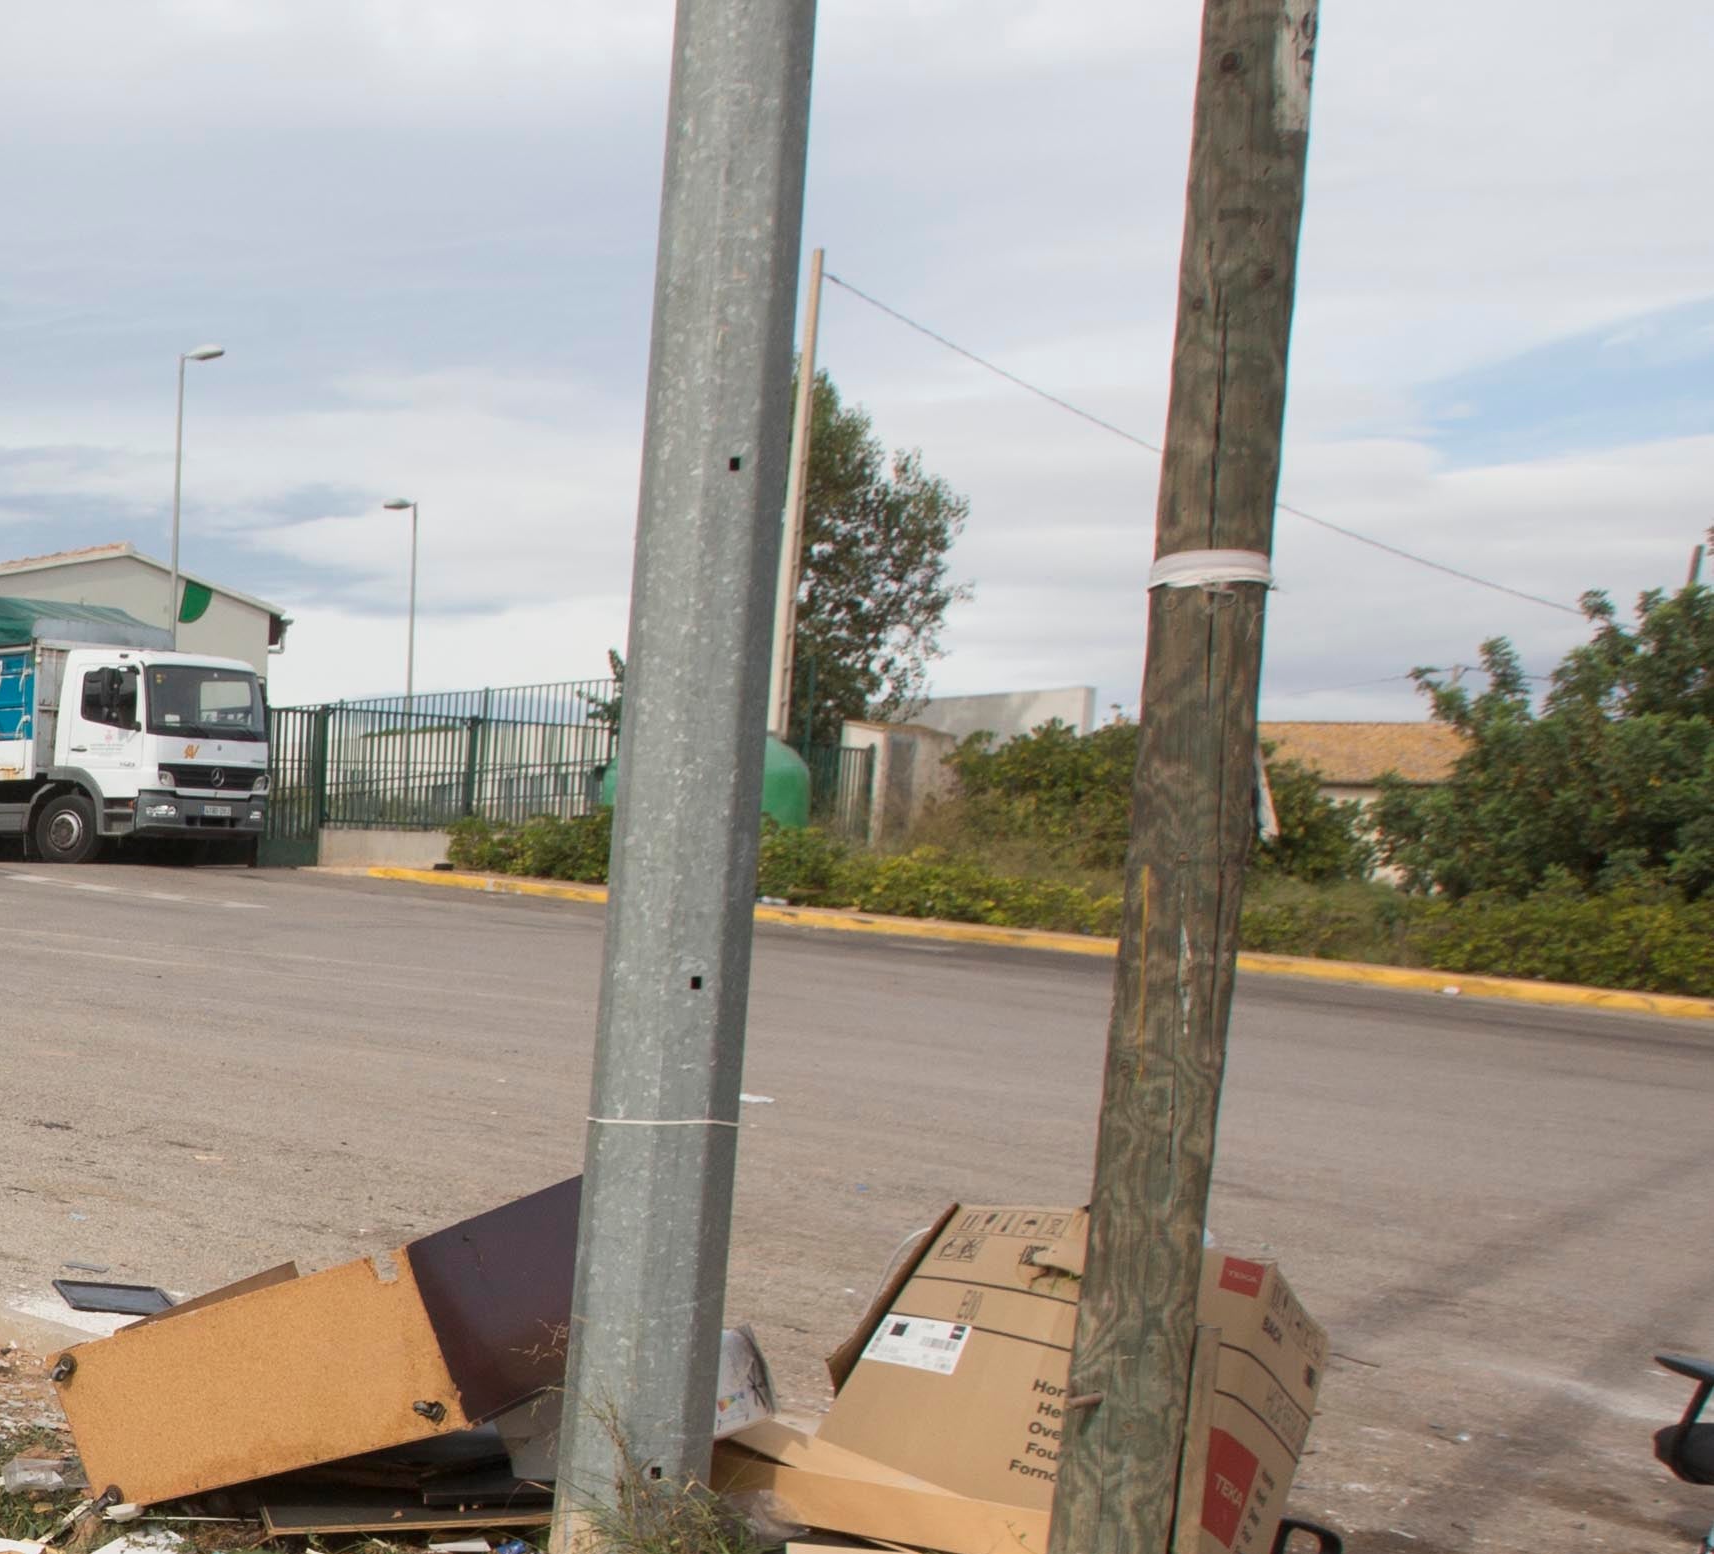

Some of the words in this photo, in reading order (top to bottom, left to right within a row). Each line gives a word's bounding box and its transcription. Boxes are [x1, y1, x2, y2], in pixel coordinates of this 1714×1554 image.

[1032, 1378, 1066, 1398] Hor
[1037, 1402, 1062, 1418] He
[1028, 1421, 1061, 1440] Ove
[1025, 1441, 1057, 1461] Fou
[1214, 1472, 1244, 1510] TEKA
